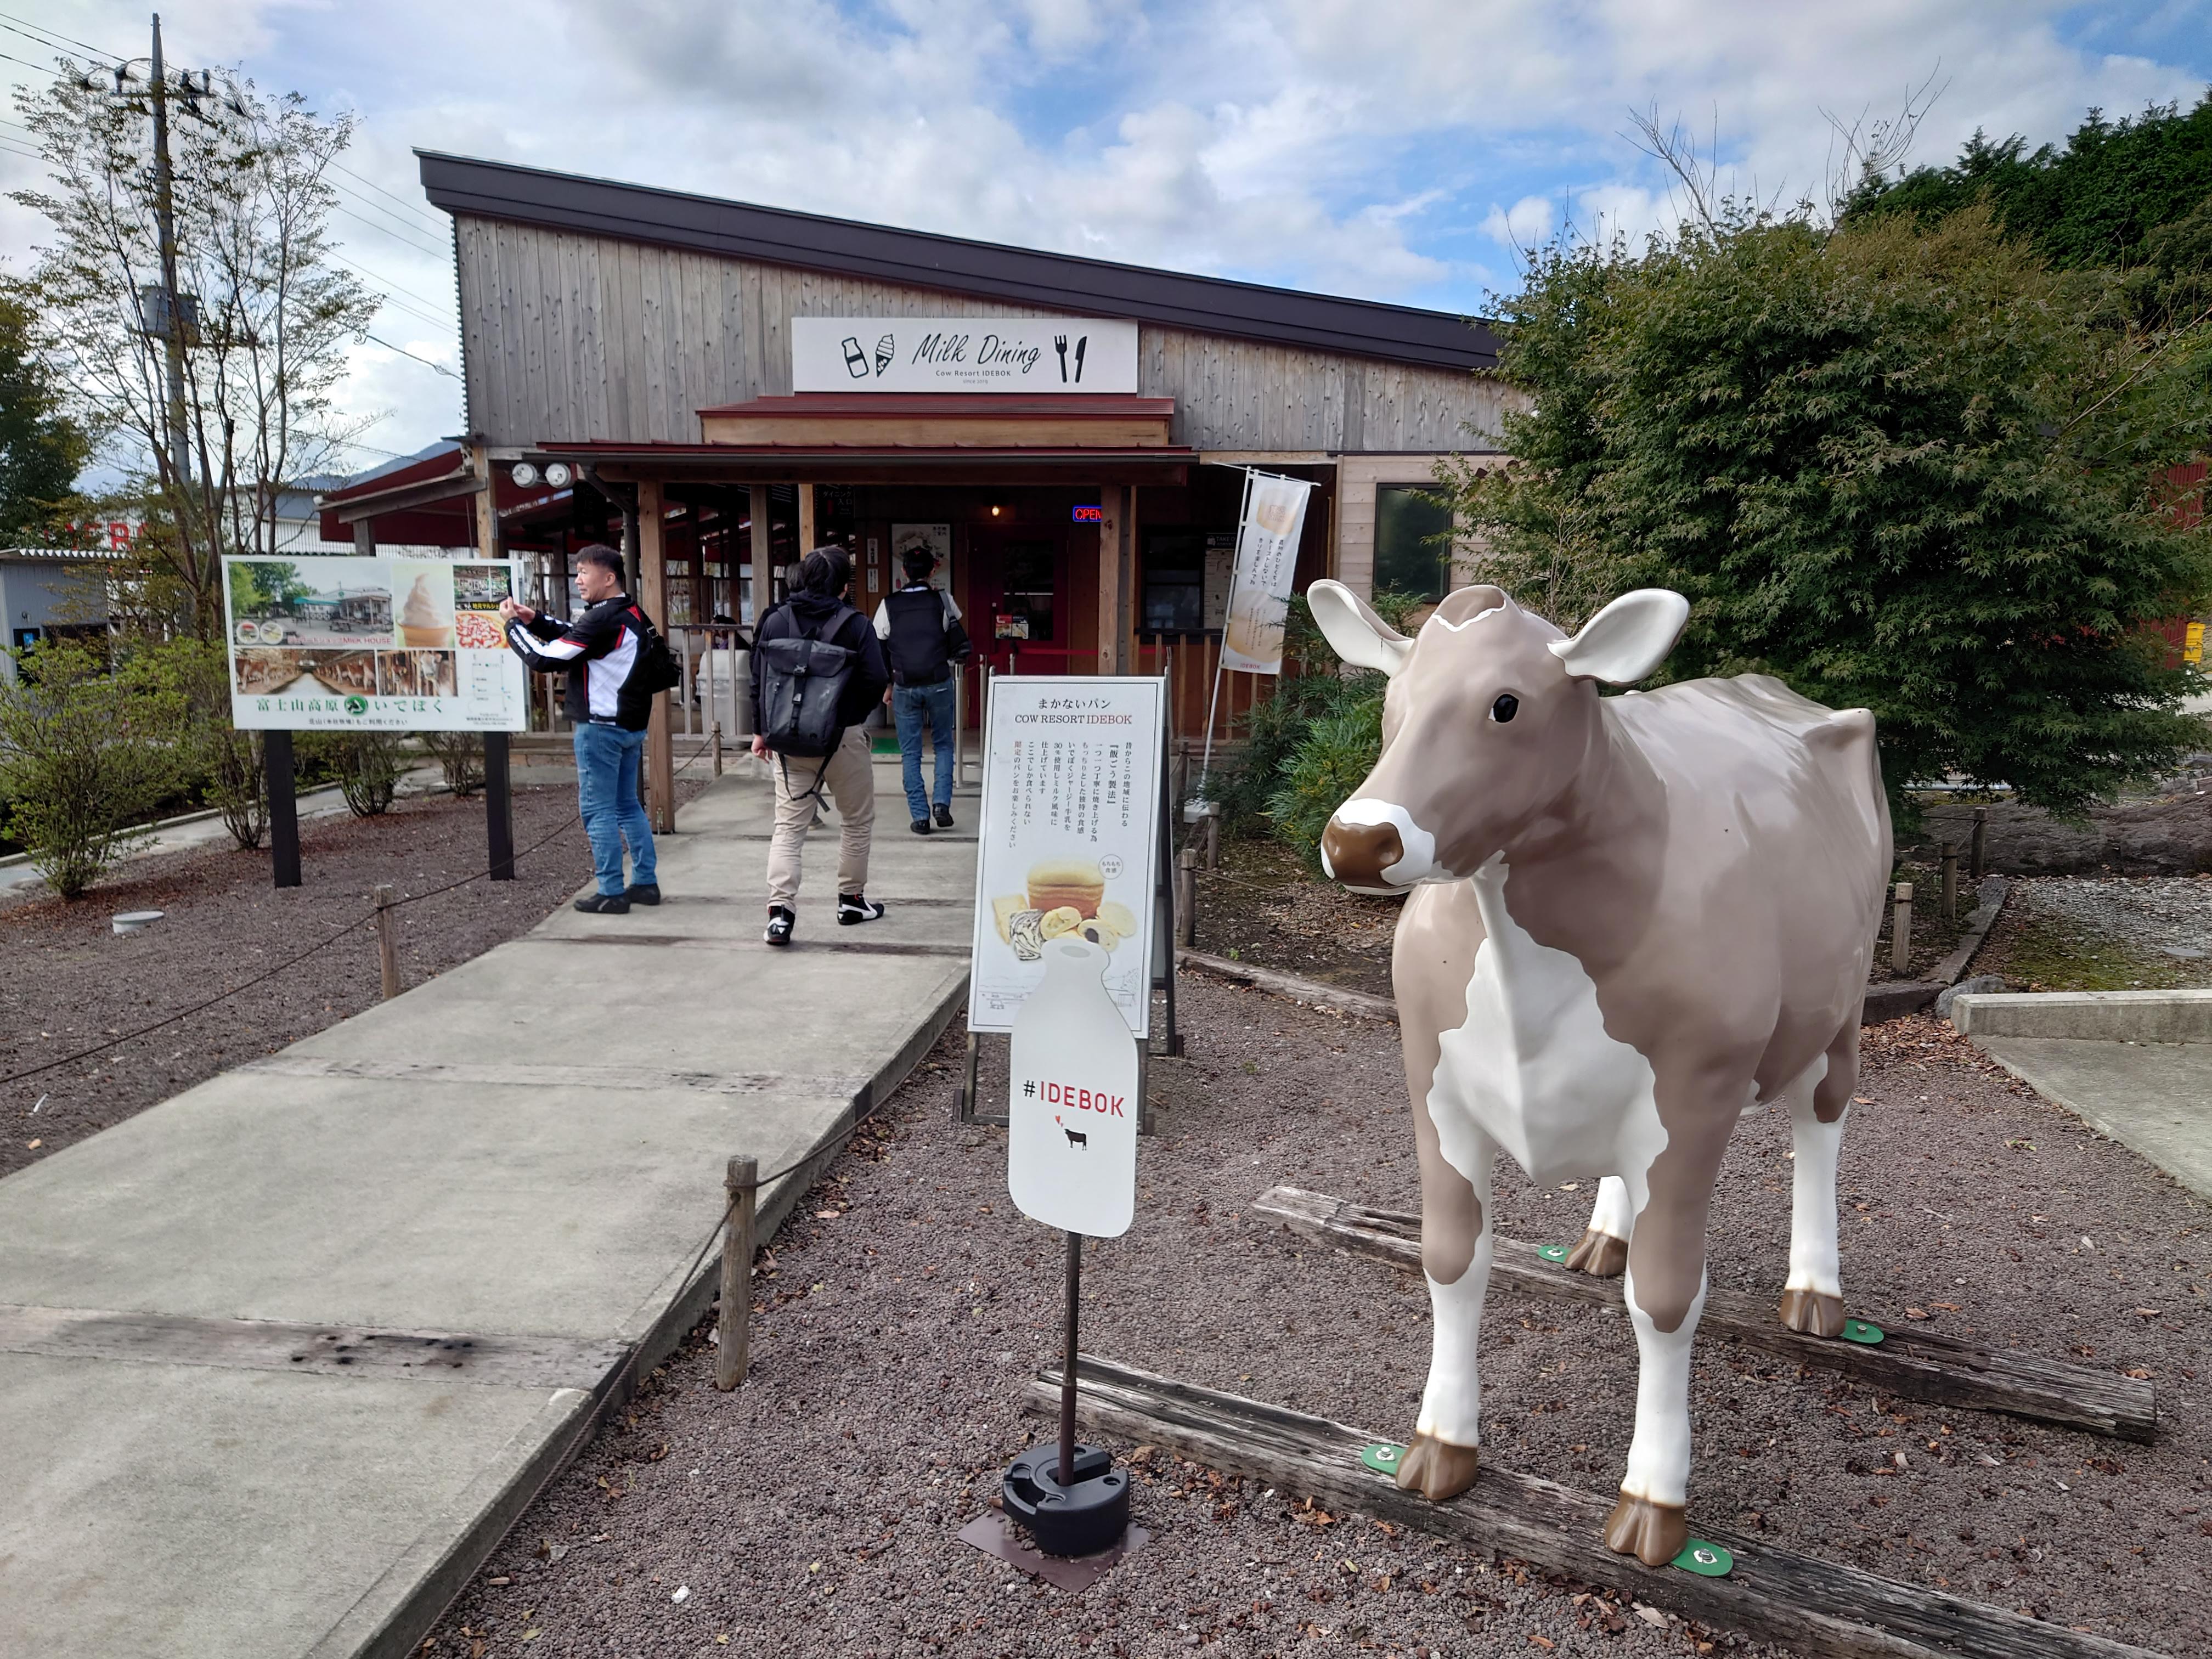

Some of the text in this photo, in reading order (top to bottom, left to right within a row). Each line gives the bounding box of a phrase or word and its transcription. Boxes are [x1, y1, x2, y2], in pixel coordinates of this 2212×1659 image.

[912, 333, 1041, 374] Milk Dining
[256, 698, 338, 712] 富士山高原
[1015, 714, 1132, 725] COW RESORT IDEBOK
[1038, 698, 1111, 709] まかないパン
[1024, 742, 1034, 825] ここでしか食べられない
[1039, 741, 1048, 794] 仕上げています
[1023, 1080, 1124, 1118] #IDEBOK
